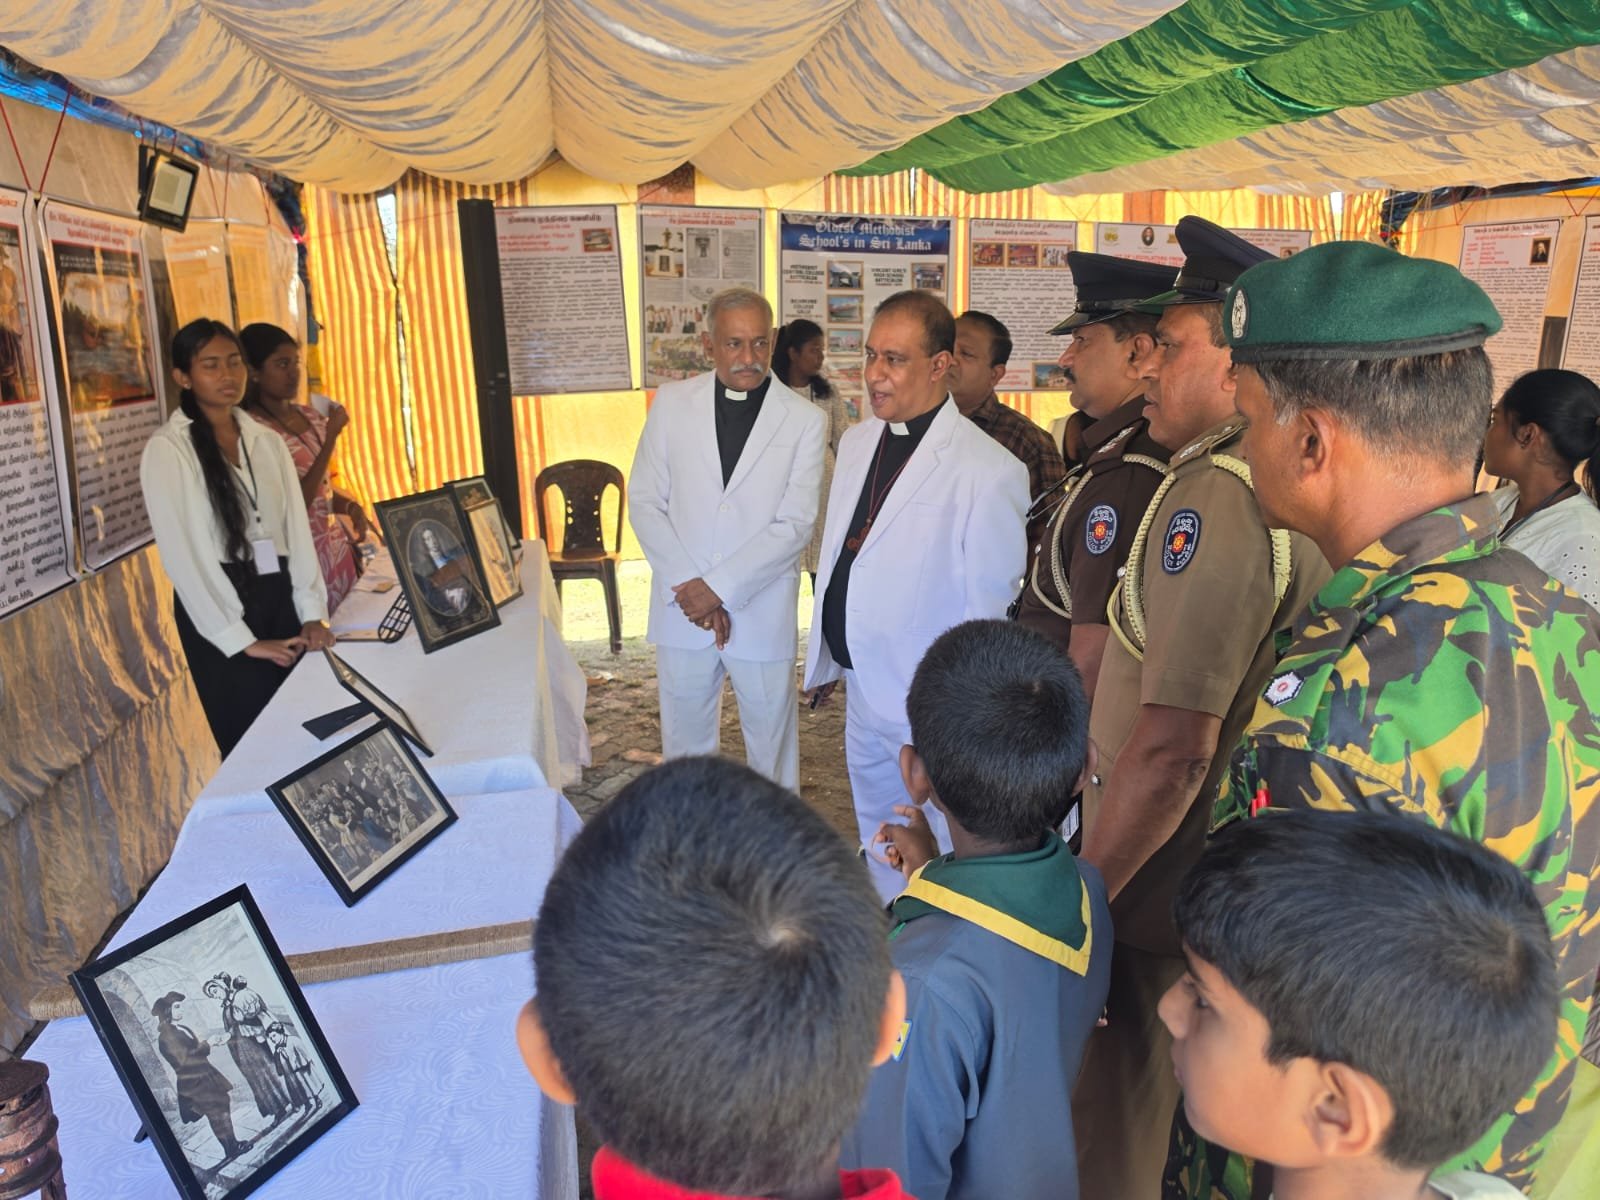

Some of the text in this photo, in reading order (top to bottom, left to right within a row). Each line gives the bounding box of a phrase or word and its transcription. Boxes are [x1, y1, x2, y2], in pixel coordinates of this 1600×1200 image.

[815, 220, 915, 236] Oldest Methodist
[799, 233, 932, 251] School's in Sri Lanka
